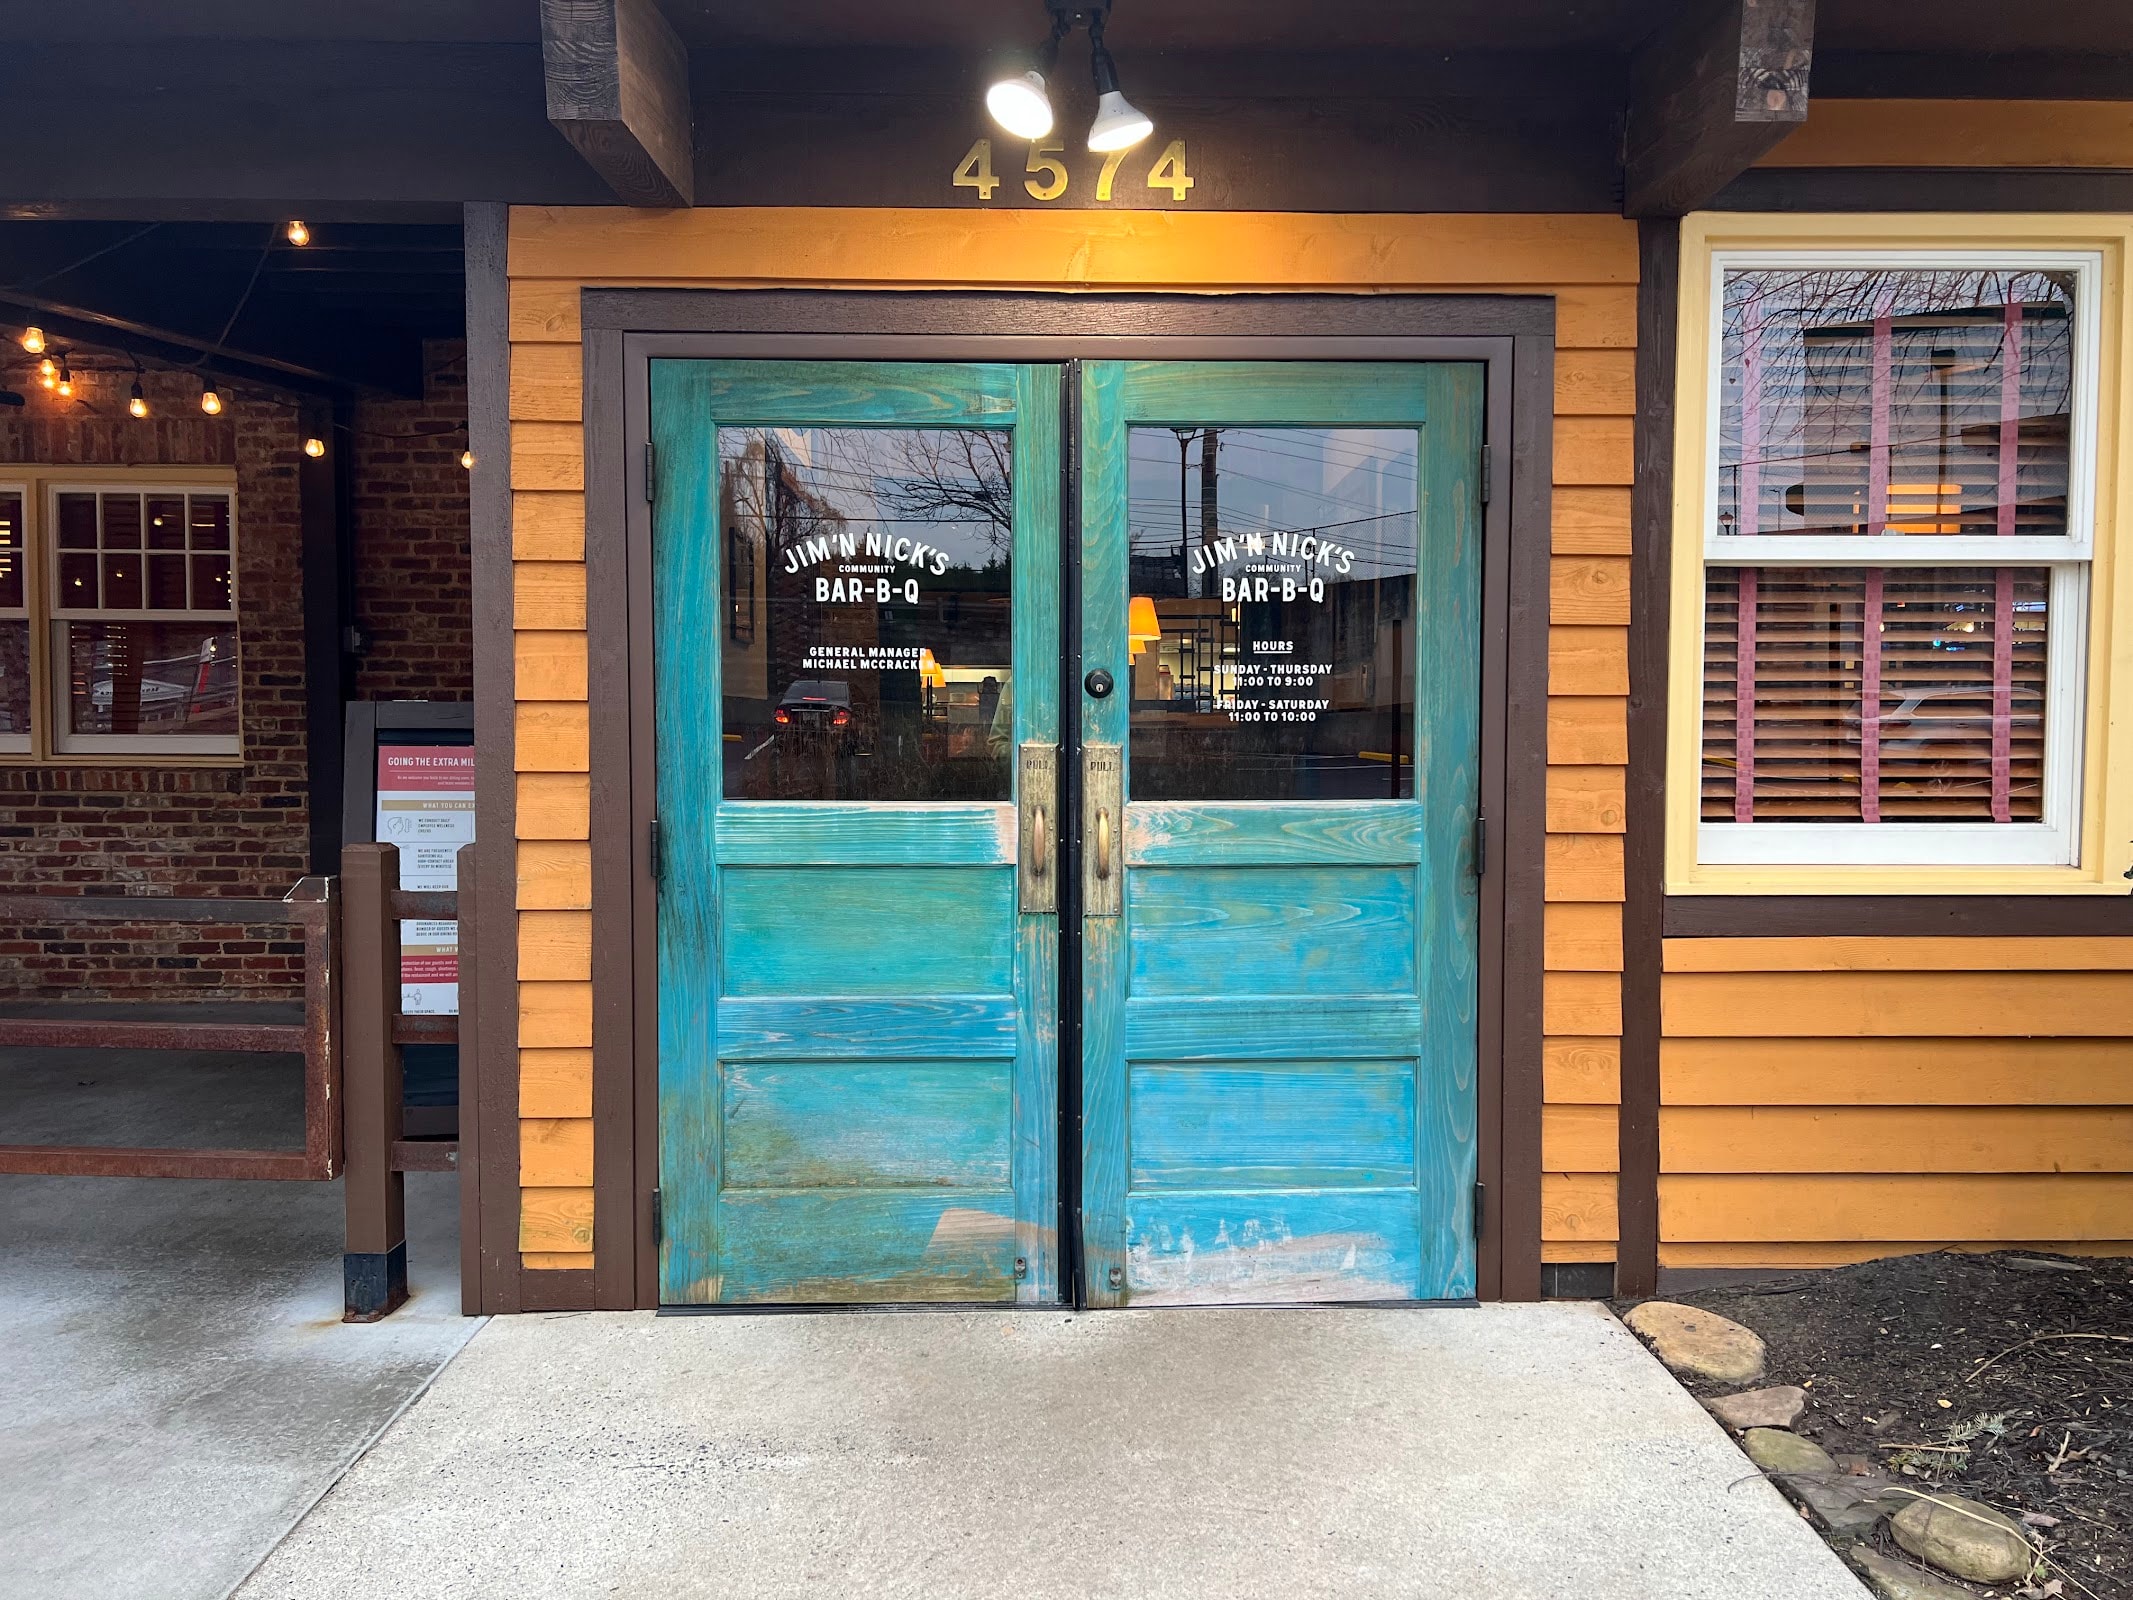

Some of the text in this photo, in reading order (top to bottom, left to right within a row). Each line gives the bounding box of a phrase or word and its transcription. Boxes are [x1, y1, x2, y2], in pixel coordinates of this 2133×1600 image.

[953, 139, 1195, 201] 4574
[865, 532, 950, 576] NICK'S
[1272, 531, 1355, 574] NICK'S
[838, 564, 896, 574] COMMUNITY
[1245, 564, 1301, 573] COMMUNITY
[815, 577, 919, 605] BAR-B-Q
[1222, 577, 1324, 604] BAR-B-Q
[1253, 641, 1294, 651] HOURS
[809, 647, 926, 658] GENERAL MANAGER
[802, 659, 934, 670] MICHAEL MCCRACKN
[1214, 664, 1261, 674] SUNDAY
[1270, 664, 1332, 674] THURSDAY
[1232, 676, 1314, 686] 11:00 TO 9:00
[1216, 700, 1258, 710] FRIDAY
[1269, 700, 1329, 710] SATURDAY
[1228, 712, 1316, 722] 11:00 TO 10:00
[388, 757, 475, 766] GOING THE EXTRA MIL
[1026, 760, 1051, 770] PULL
[1090, 761, 1115, 772] PULL
